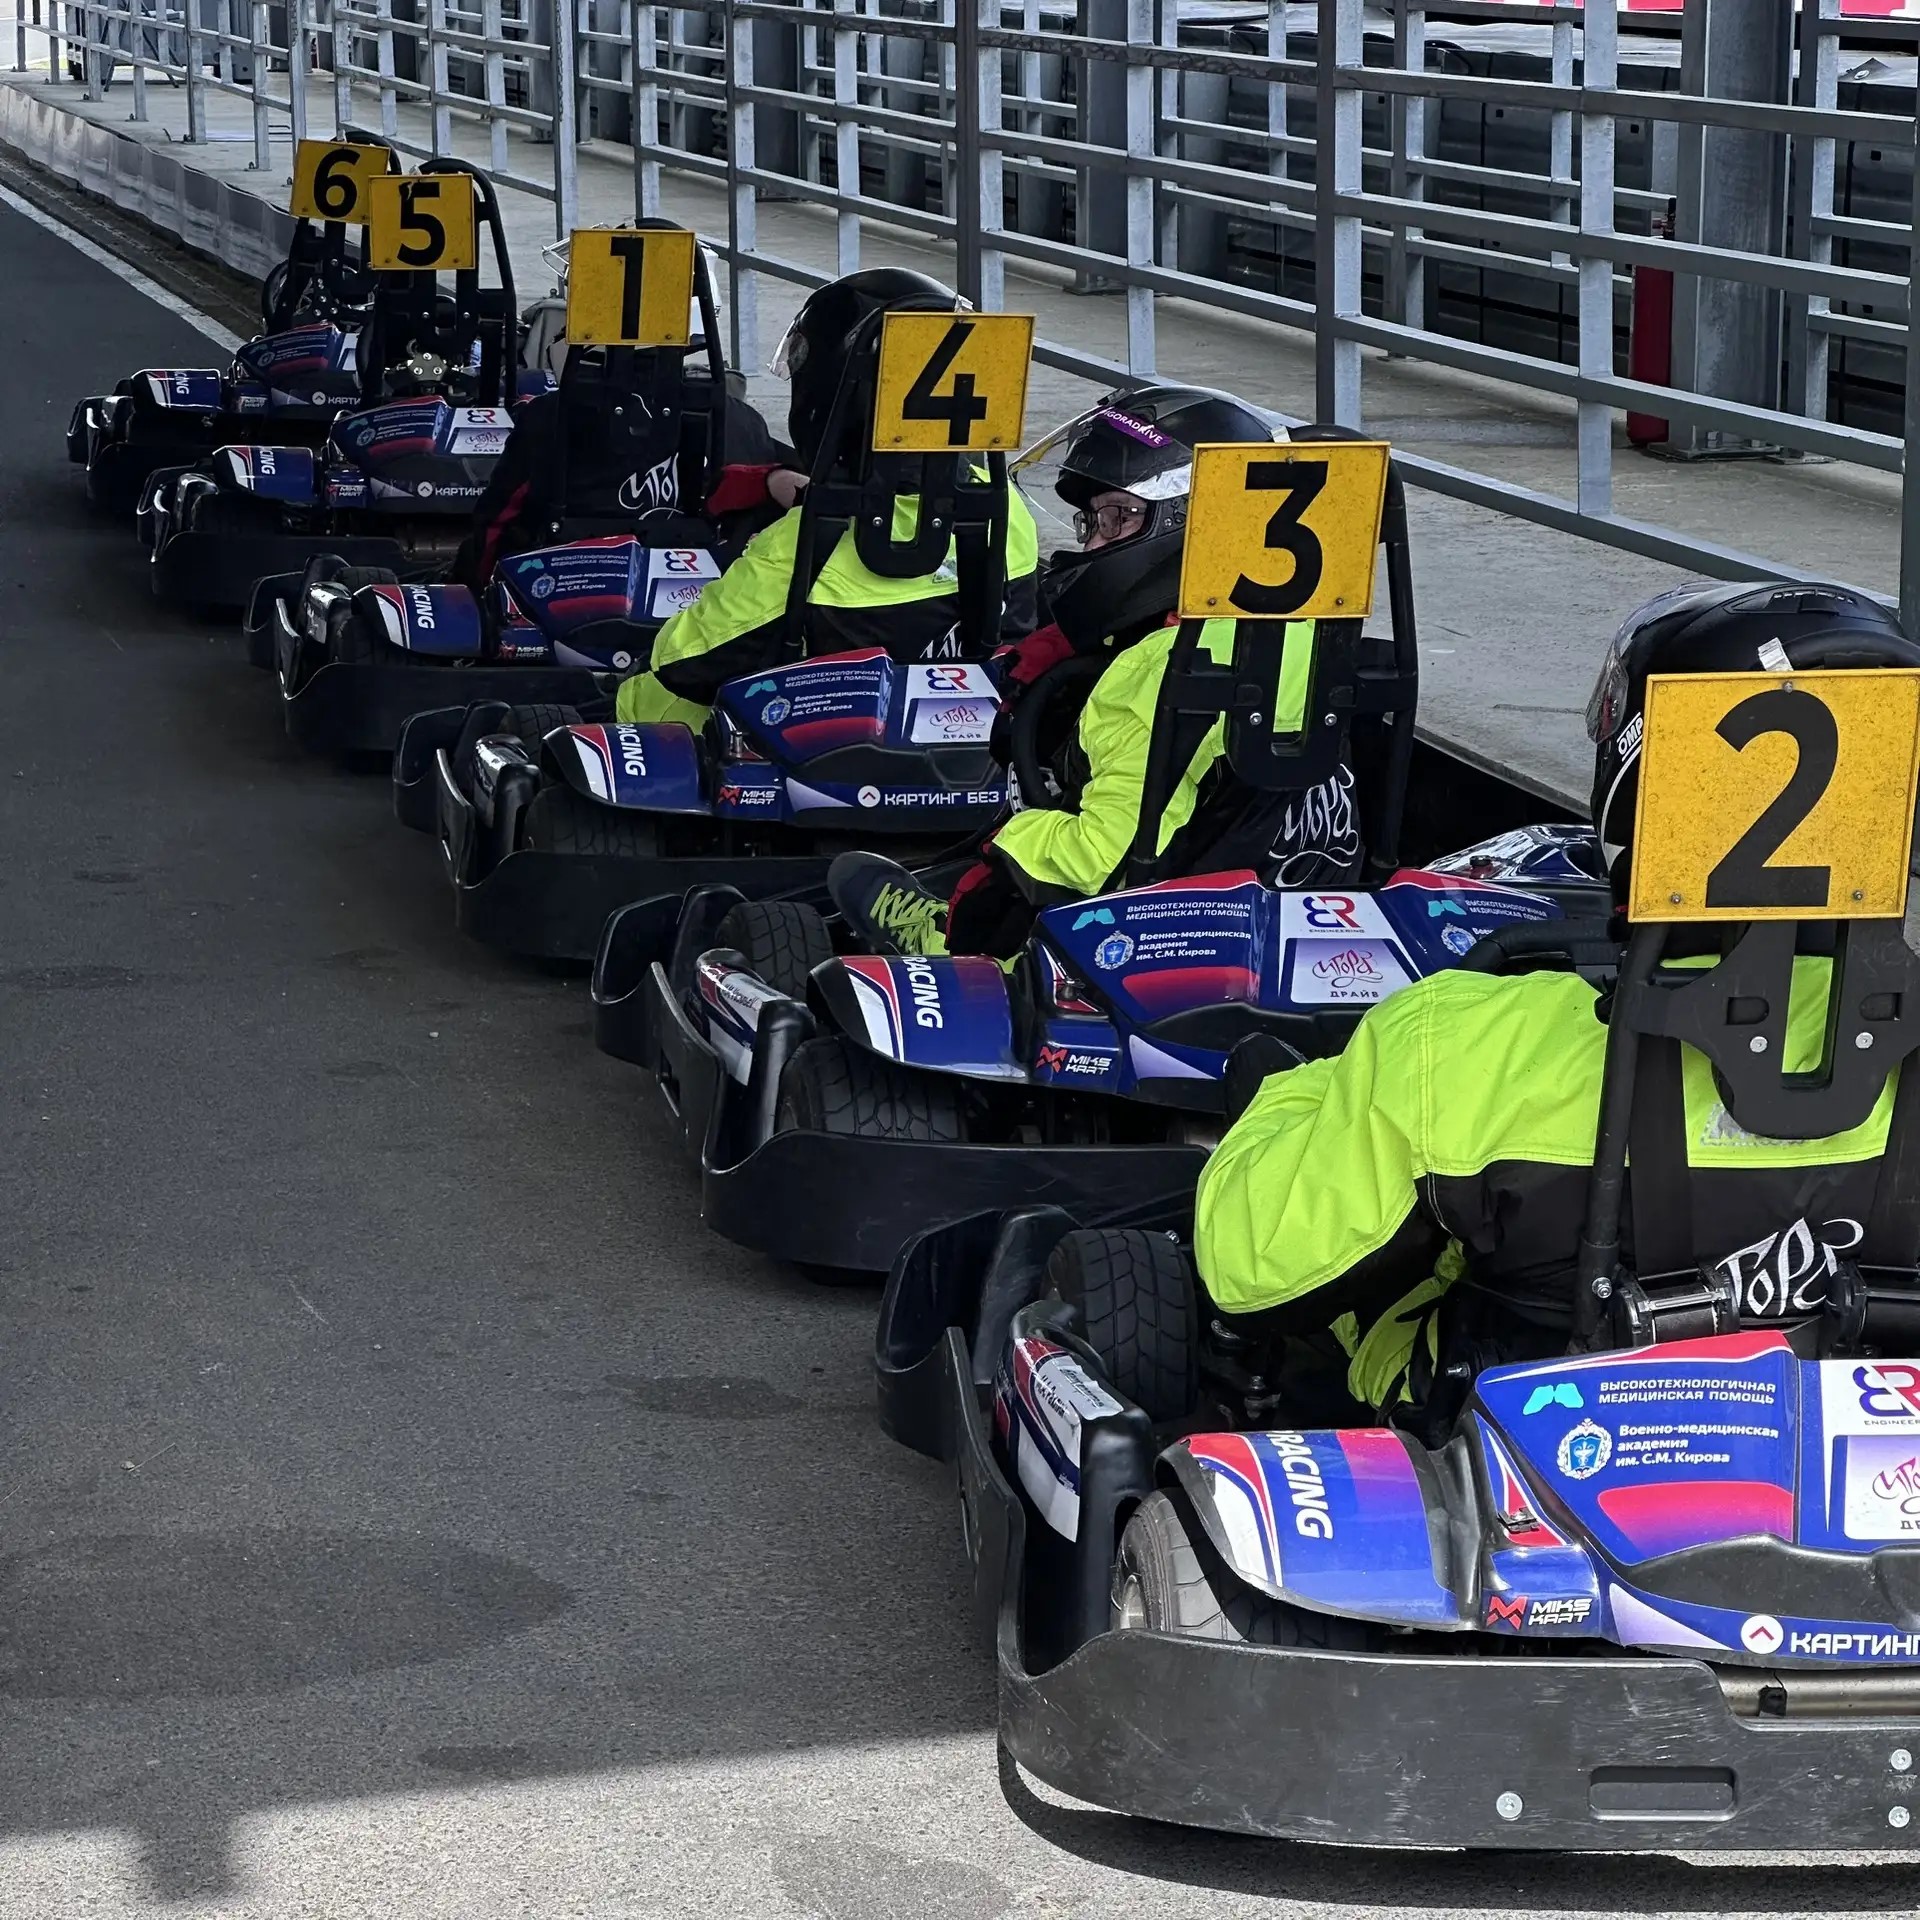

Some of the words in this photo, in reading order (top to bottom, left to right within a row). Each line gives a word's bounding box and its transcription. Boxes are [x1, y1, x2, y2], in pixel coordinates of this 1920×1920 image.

[313, 148, 360, 219] 6
[396, 181, 446, 267] 5
[609, 236, 645, 340] 1
[901, 322, 988, 446] 4
[1228, 460, 1329, 615] 3
[1618, 717, 1644, 755] OMP
[884, 792, 962, 806] КАРТИНГ
[966, 791, 1000, 804] БЕЗ
[1705, 689, 1839, 908] 2
[1126, 901, 1252, 913] ВЫСОКОТЕХНОЛОГИЧНАЯ
[1125, 909, 1200, 921] МЕДИЦИНСКАЯ
[1203, 909, 1250, 918] ПОМОЩЬ
[1139, 930, 1252, 941] Военно-медицинская
[1137, 941, 1189, 952] академия
[1135, 953, 1154, 961] им.
[1154, 949, 1177, 959] С.М.
[1177, 949, 1217, 957] Кирова
[901, 955, 944, 1030] RACING
[1329, 989, 1380, 998] ДРАЙВ
[1068, 1053, 1113, 1068] MIKS
[1064, 1063, 1110, 1076] KART
[1600, 1378, 1777, 1393] ВЫСОКОТЕХНОЛОГИЧНАЯ
[1598, 1391, 1704, 1404] МЕДИЦИНСКАЯ
[1708, 1391, 1775, 1405] ПОМОЩЬ
[1619, 1424, 1780, 1439] Военно-медицинская
[1617, 1438, 1690, 1452] академия
[1615, 1456, 1640, 1468] им.
[1641, 1452, 1673, 1465] С.М.
[1674, 1451, 1731, 1465] Кирова
[1265, 1432, 1335, 1541] RACING
[1531, 1598, 1593, 1614] MIKS
[1527, 1611, 1590, 1626] KART
